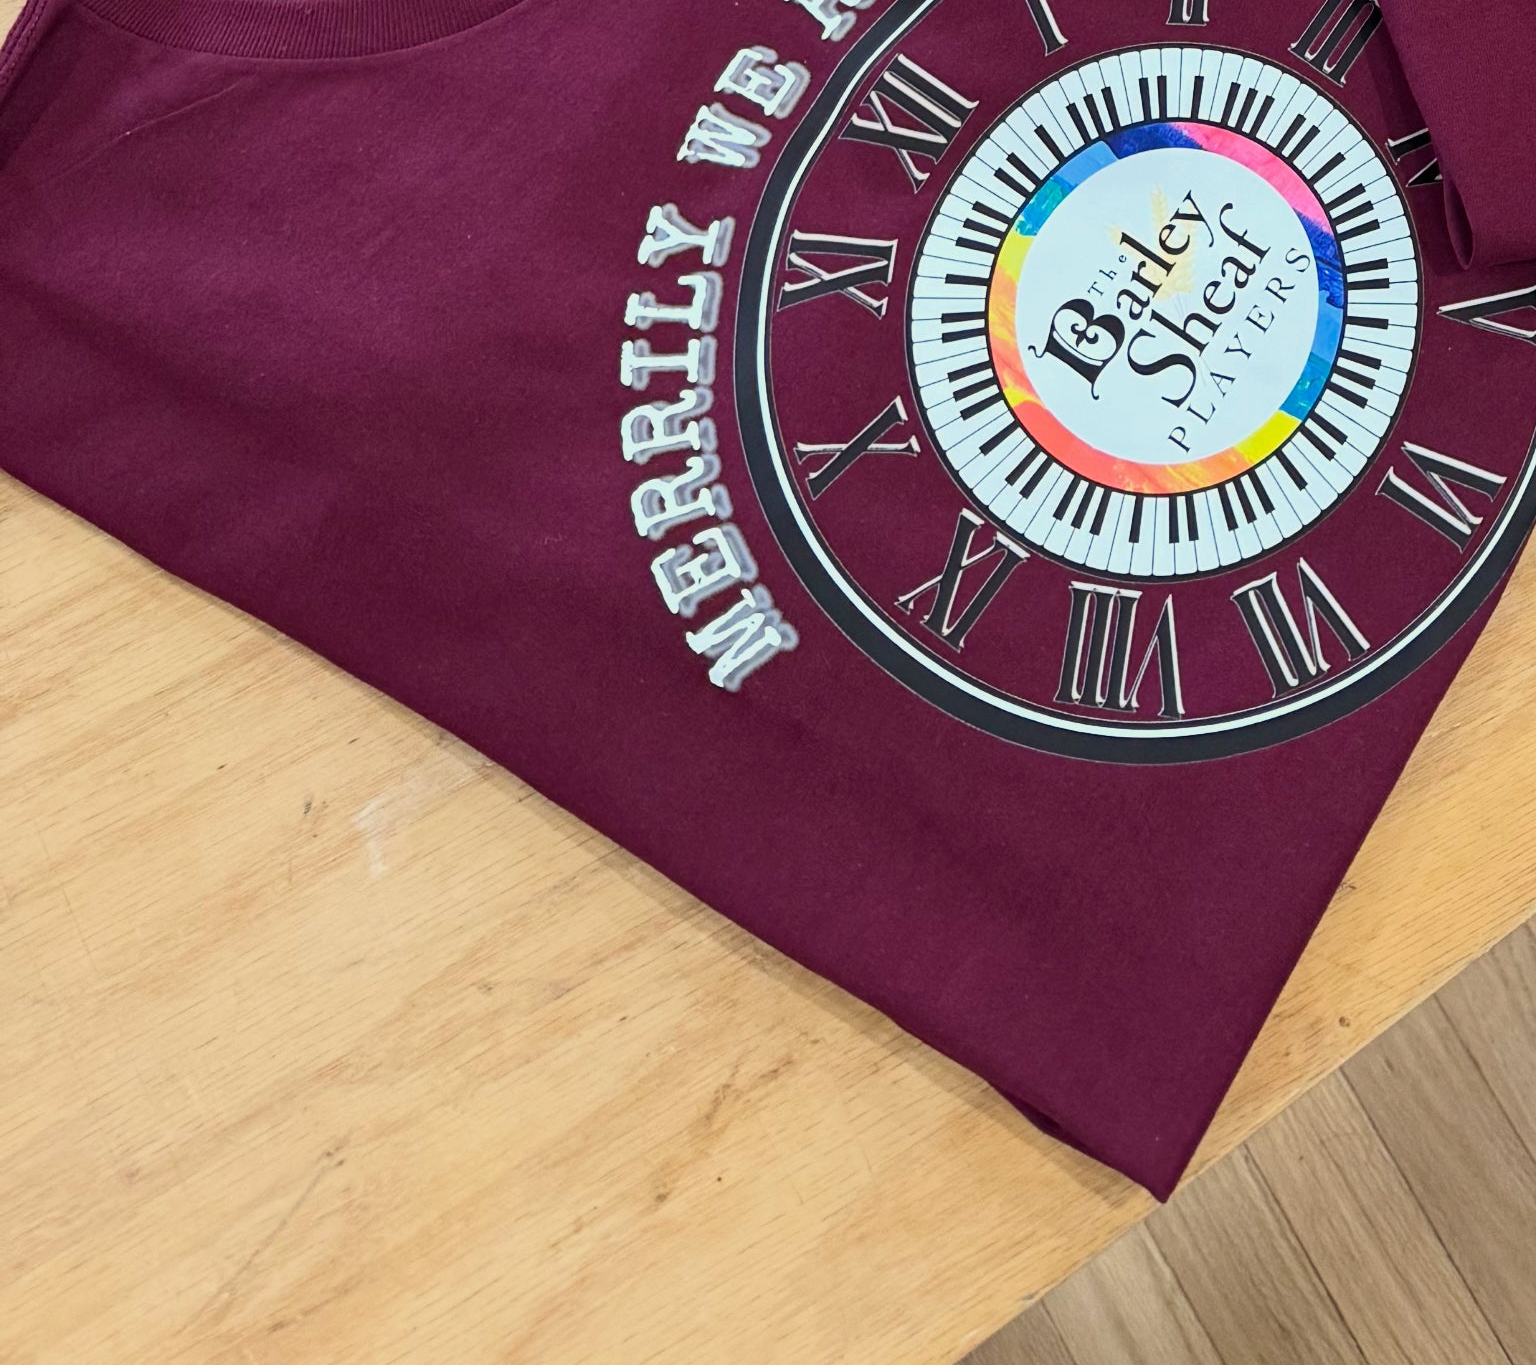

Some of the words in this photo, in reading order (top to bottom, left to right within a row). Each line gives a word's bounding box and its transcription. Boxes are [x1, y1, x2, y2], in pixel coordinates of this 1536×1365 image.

[676, 45, 811, 170] WE
[838, 52, 980, 194] XII
[776, 229, 899, 320] XI
[1027, 190, 1215, 401] Barley
[1087, 254, 1128, 298] The
[1127, 202, 1272, 408] Sheaf
[1167, 247, 1311, 453] PLAYERS
[618, 202, 799, 693] MERRILY
[795, 395, 921, 501] X
[1374, 441, 1508, 554] VI
[894, 508, 1029, 653] IX
[1053, 579, 1186, 719] VIII
[1229, 557, 1371, 699] VII
